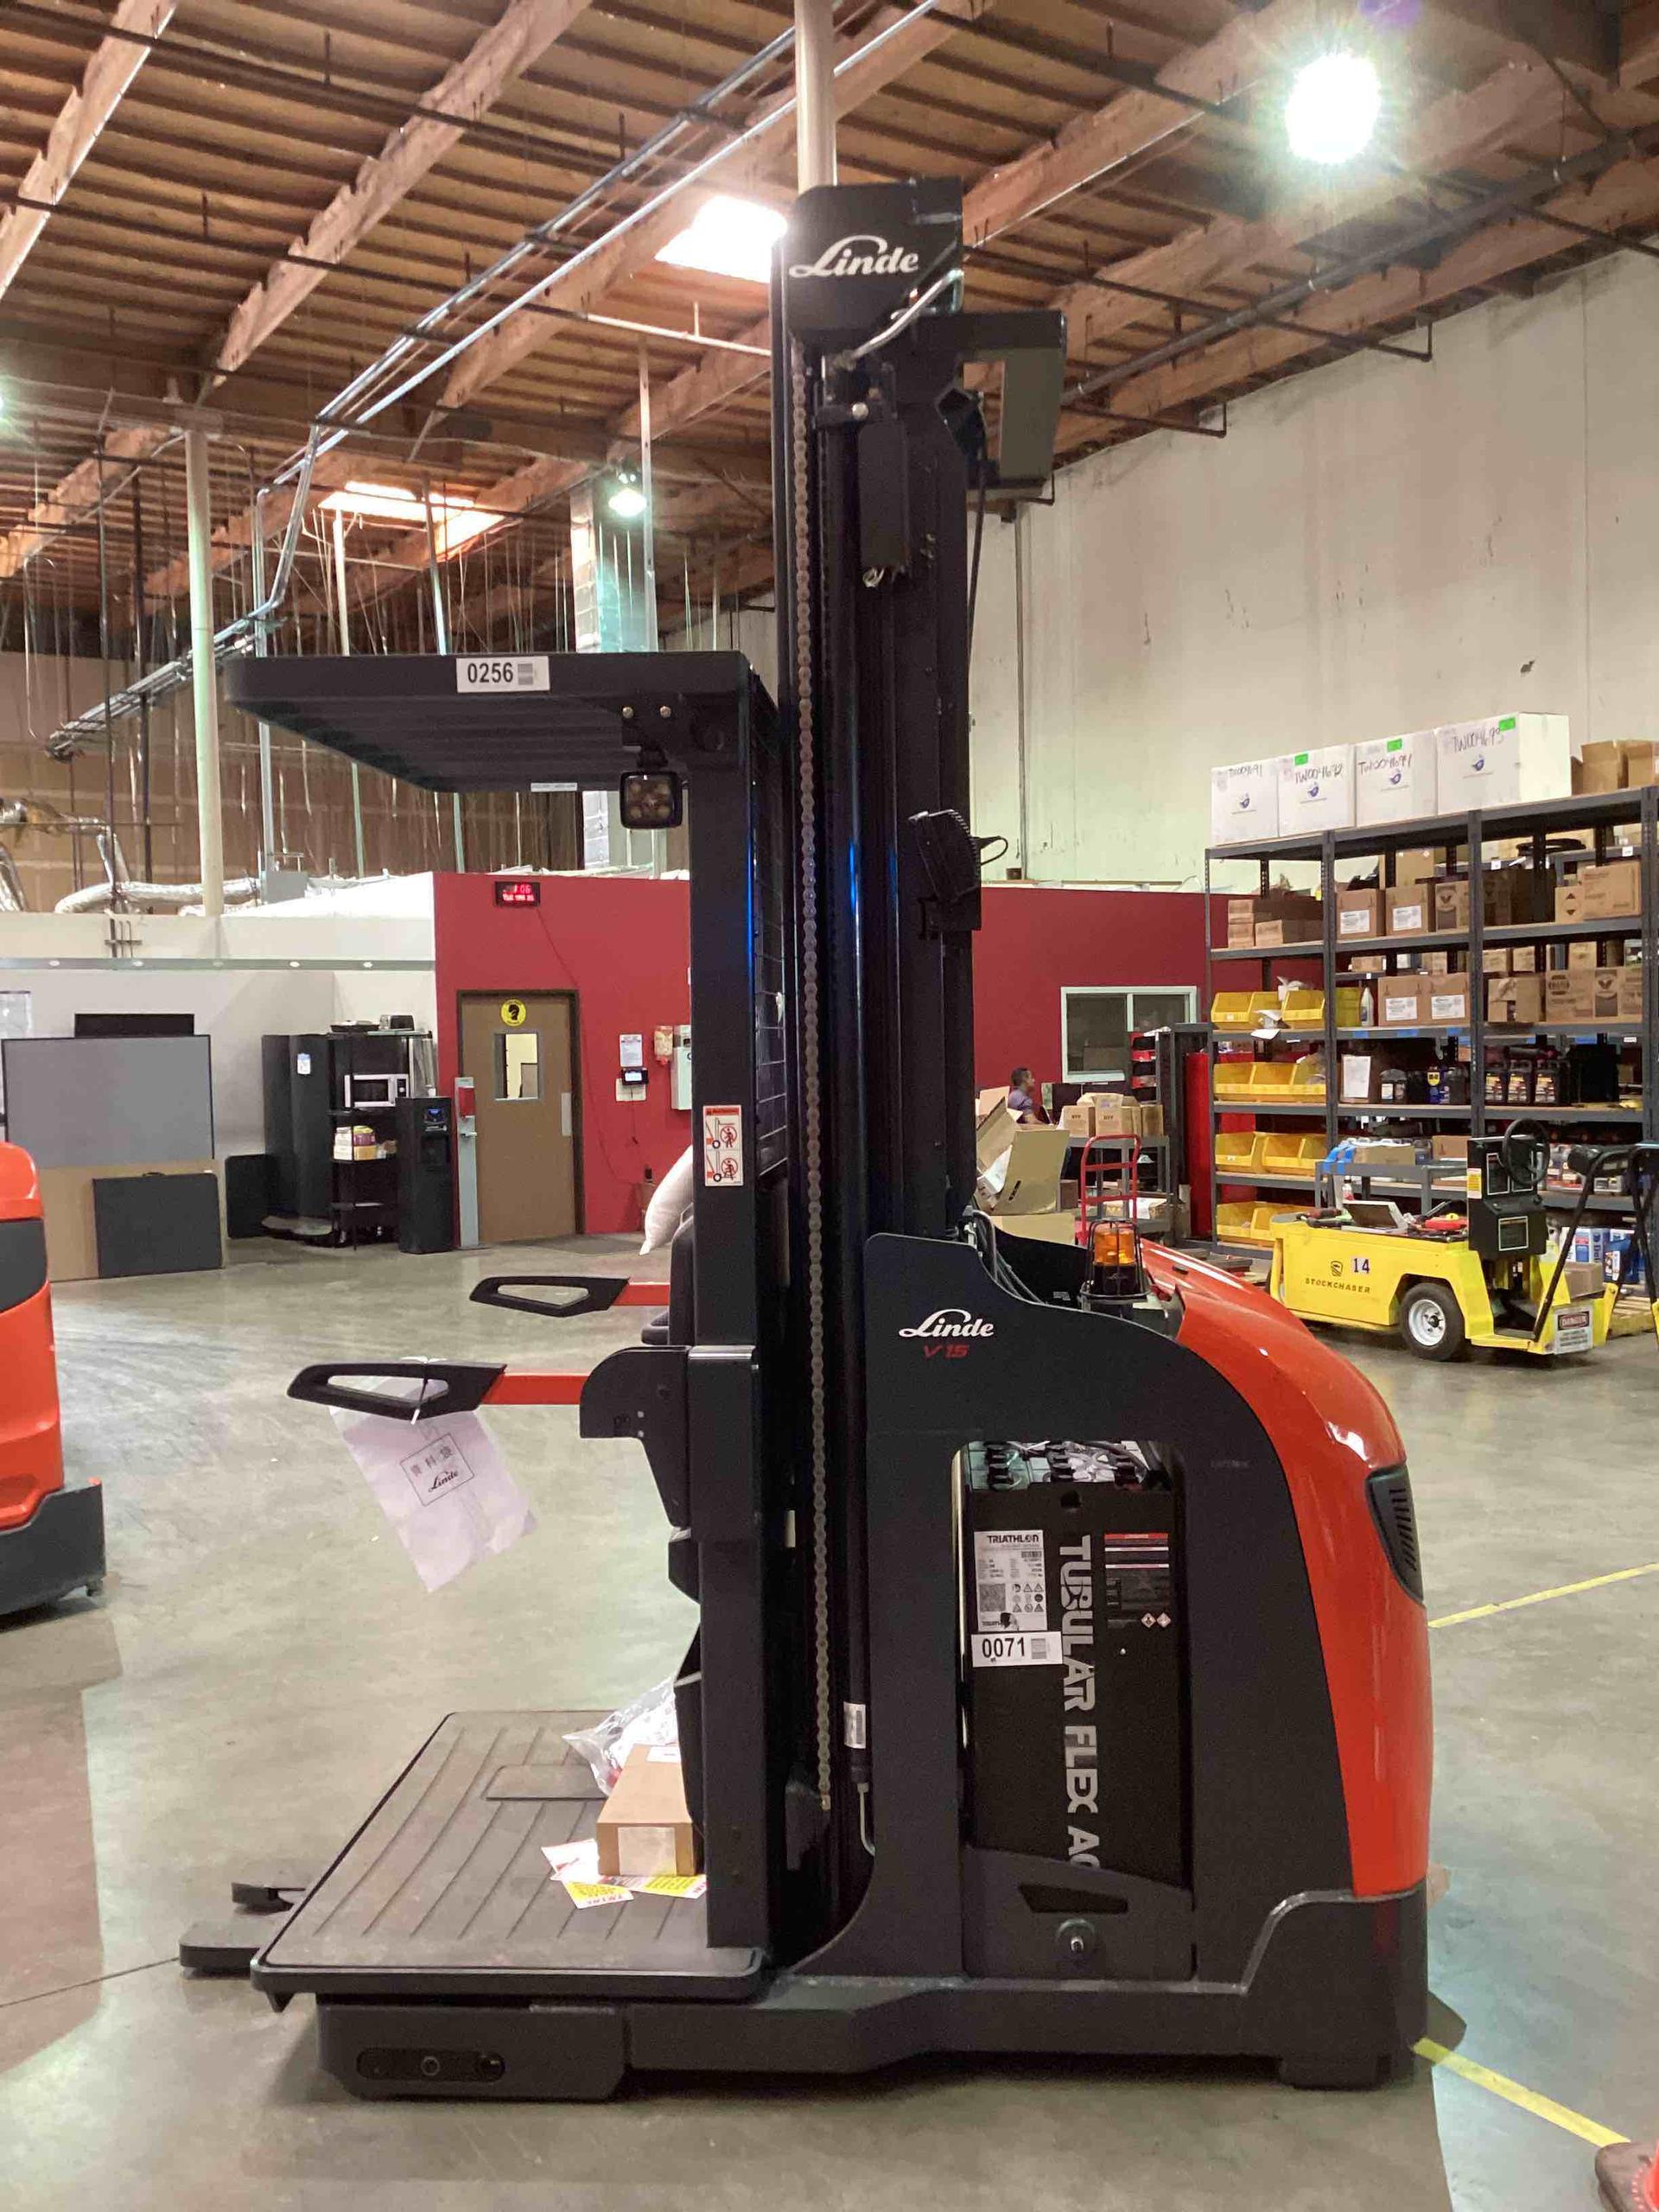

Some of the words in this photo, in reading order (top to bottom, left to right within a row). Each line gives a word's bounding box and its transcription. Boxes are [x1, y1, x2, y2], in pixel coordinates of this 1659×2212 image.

[789, 234, 918, 276] Linde
[466, 661, 514, 684] 0256
[1353, 1258, 1370, 1274] 14
[1305, 1277, 1371, 1294] STOCKCHASER
[899, 1309, 995, 1338] Linde
[1059, 1535, 1096, 1712] TUBULAR
[982, 1637, 1026, 1658] 0071
[1065, 1726, 1099, 1814] FLEX
